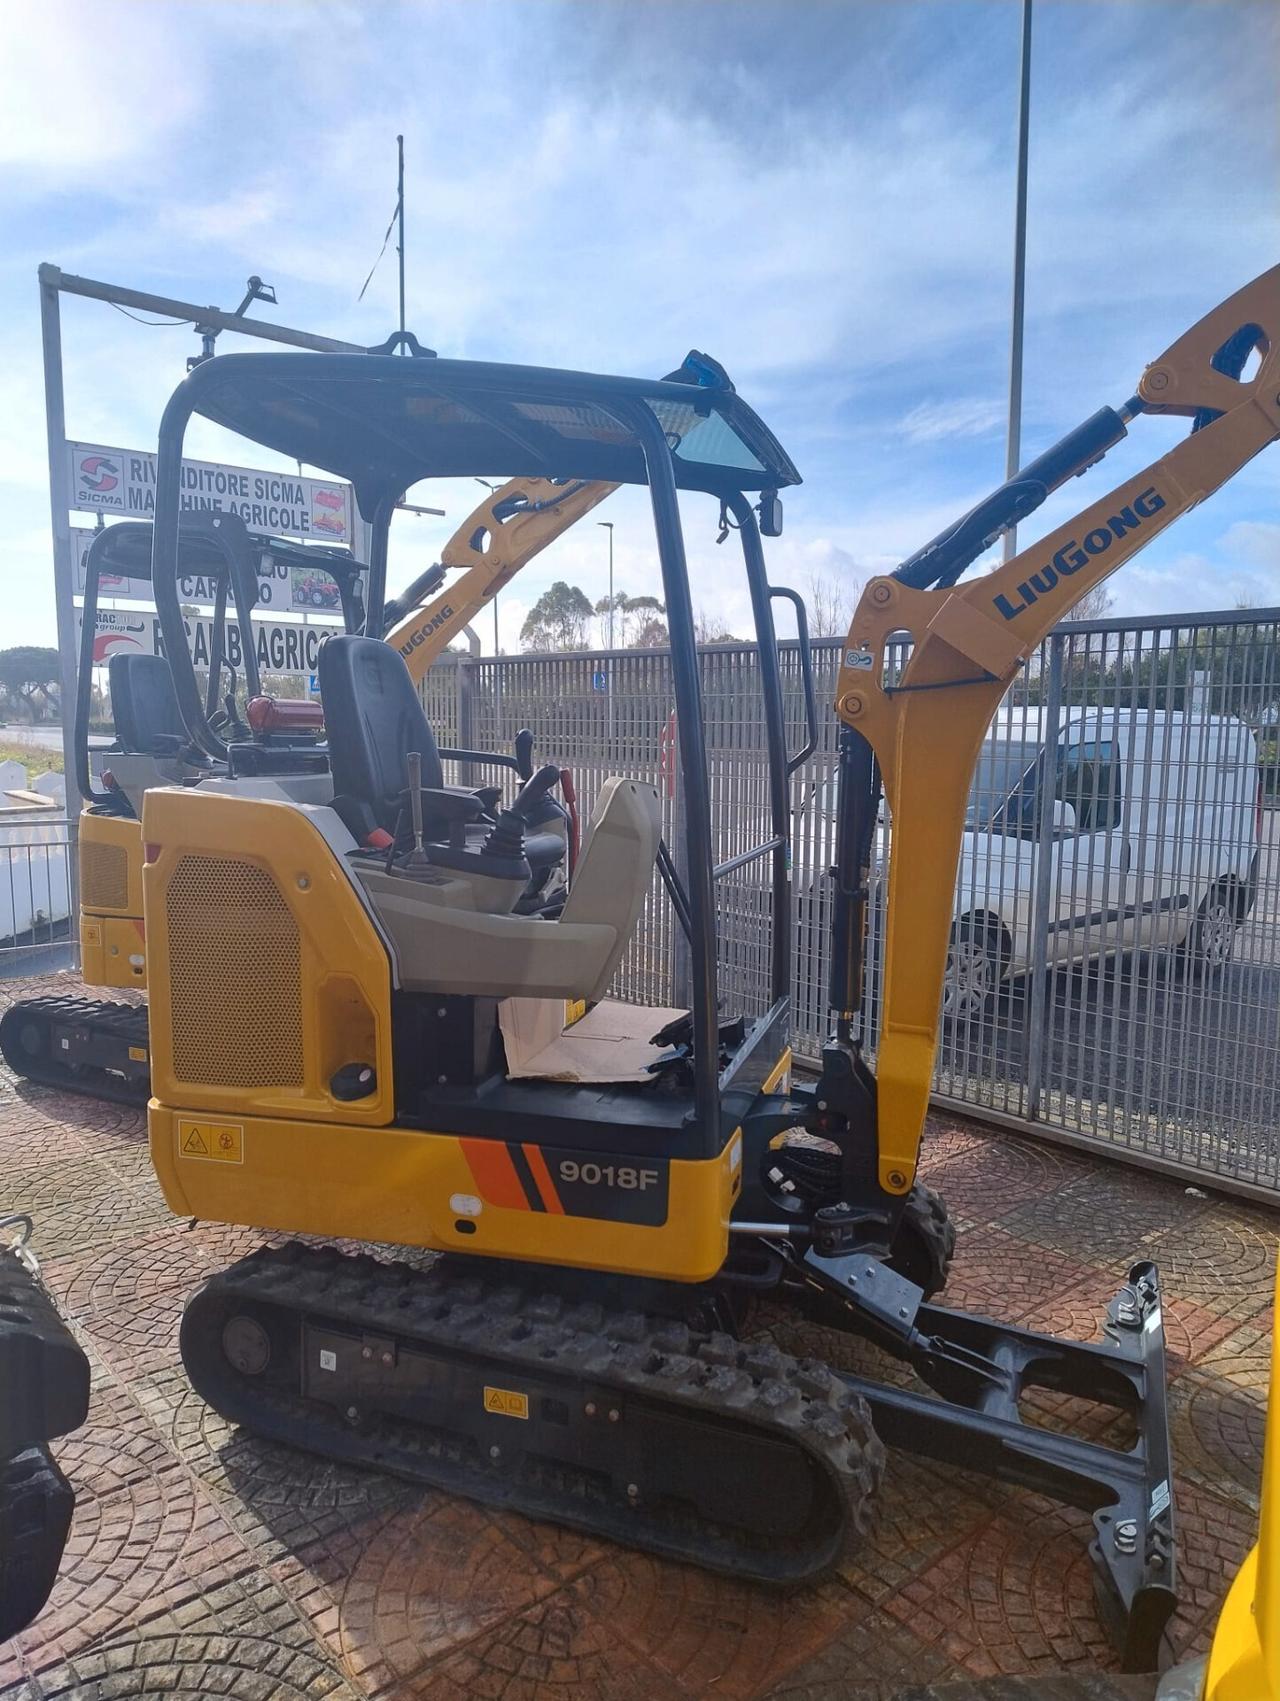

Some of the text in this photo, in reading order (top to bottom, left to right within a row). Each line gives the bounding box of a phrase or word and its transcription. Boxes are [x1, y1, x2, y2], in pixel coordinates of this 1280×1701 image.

[78, 490, 122, 505] SICMA
[255, 478, 305, 506] SICMA
[992, 487, 1167, 621] LIUGONG
[398, 604, 454, 660] IUGONG
[560, 1160, 659, 1191] 9018F
